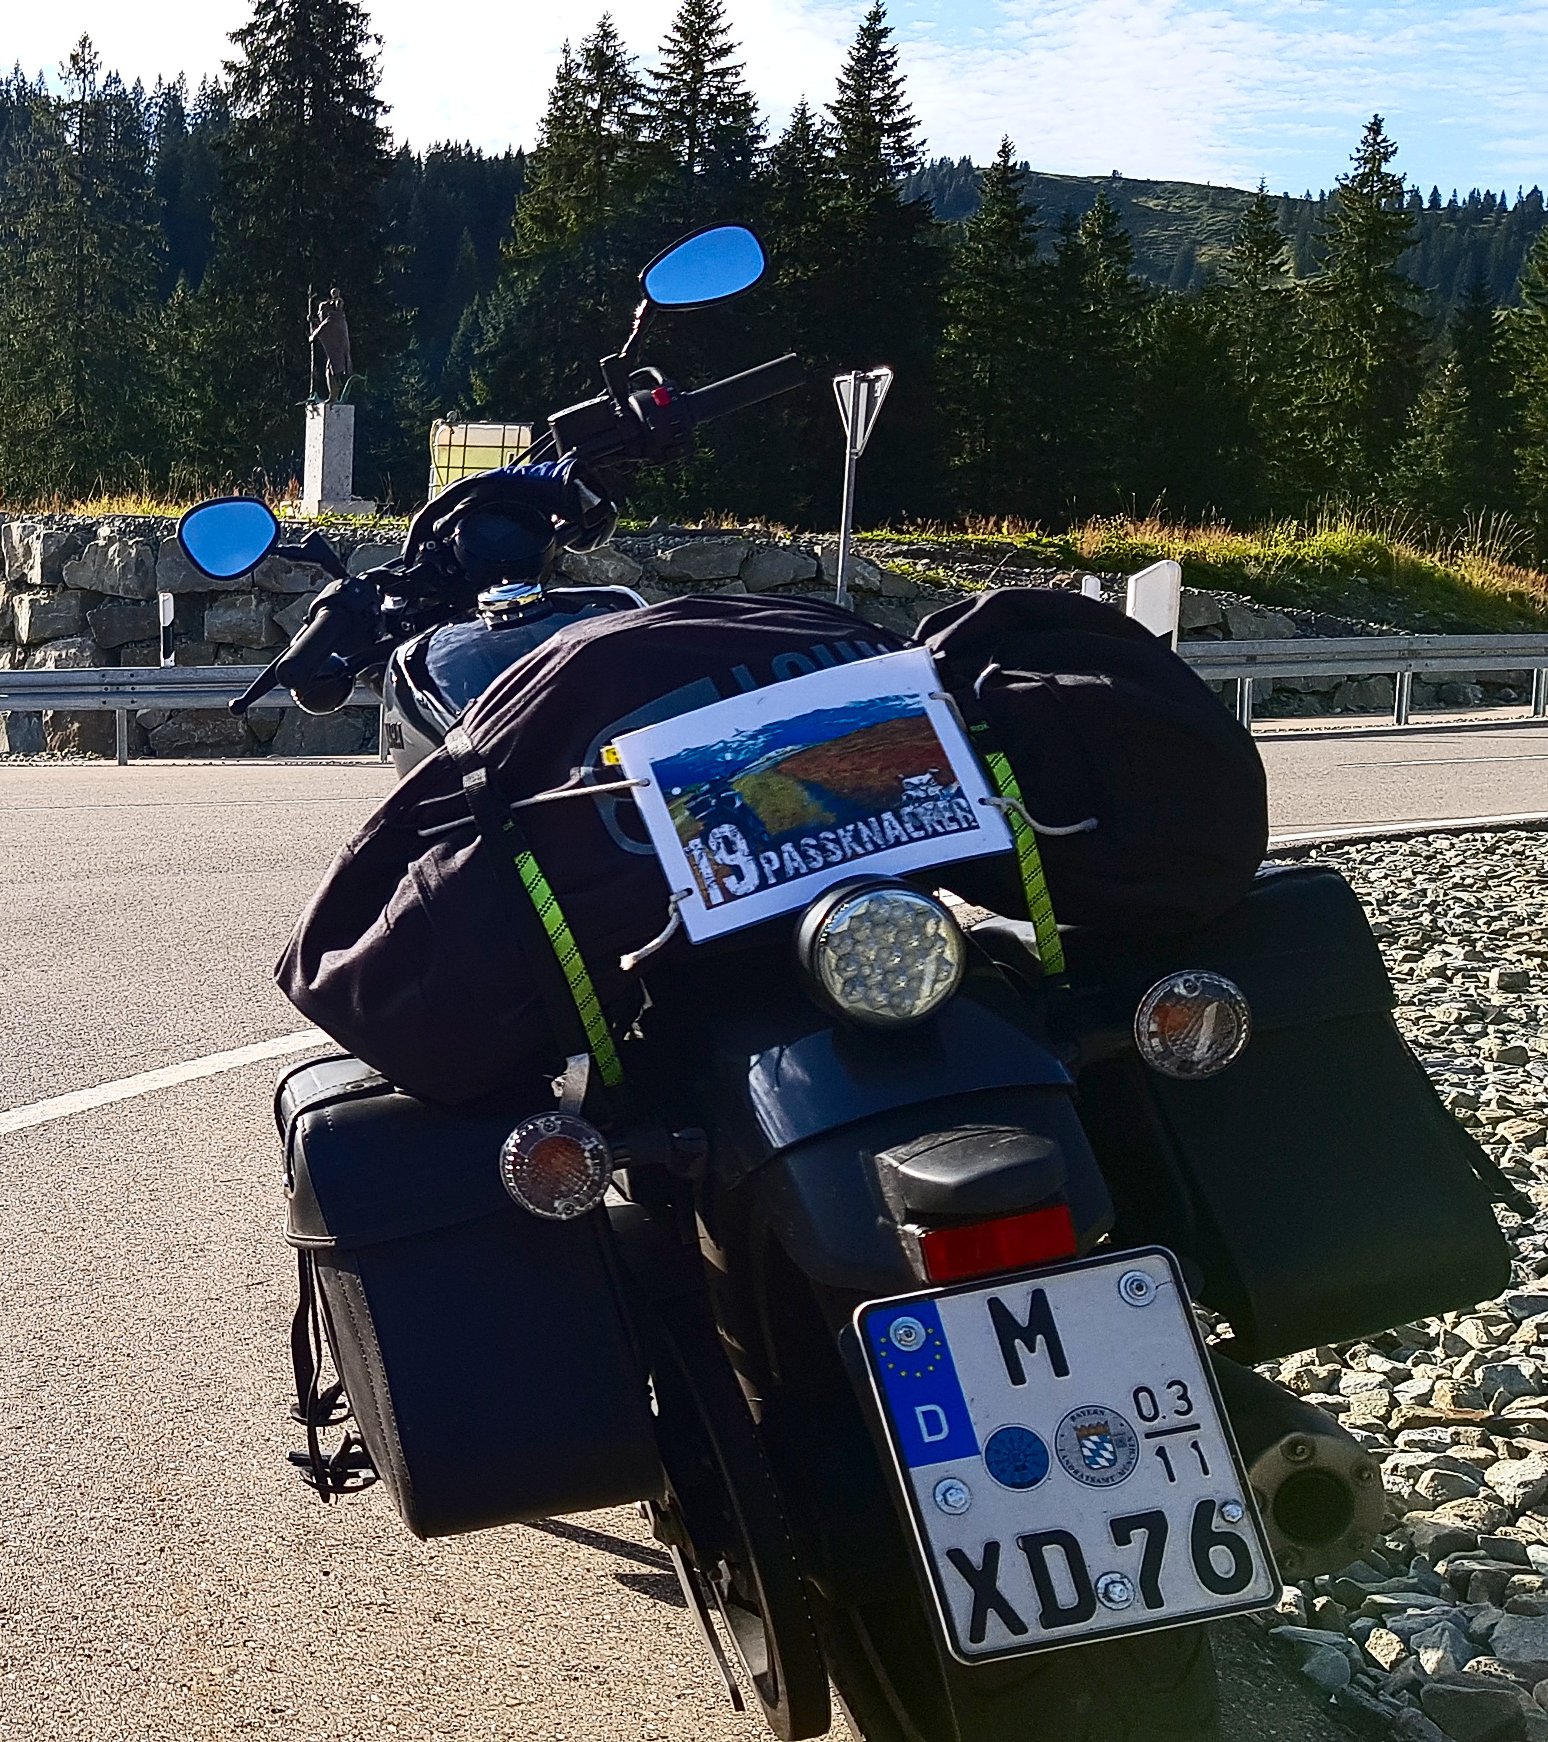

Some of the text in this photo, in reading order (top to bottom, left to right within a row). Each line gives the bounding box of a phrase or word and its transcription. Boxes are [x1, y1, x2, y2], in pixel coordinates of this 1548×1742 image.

[683, 798, 980, 906] 19 PASSKNACKER
[987, 1288, 1070, 1386] M
[914, 1404, 949, 1443] D
[1154, 1440, 1210, 1483] 11
[945, 1498, 1254, 1644] XD 76
